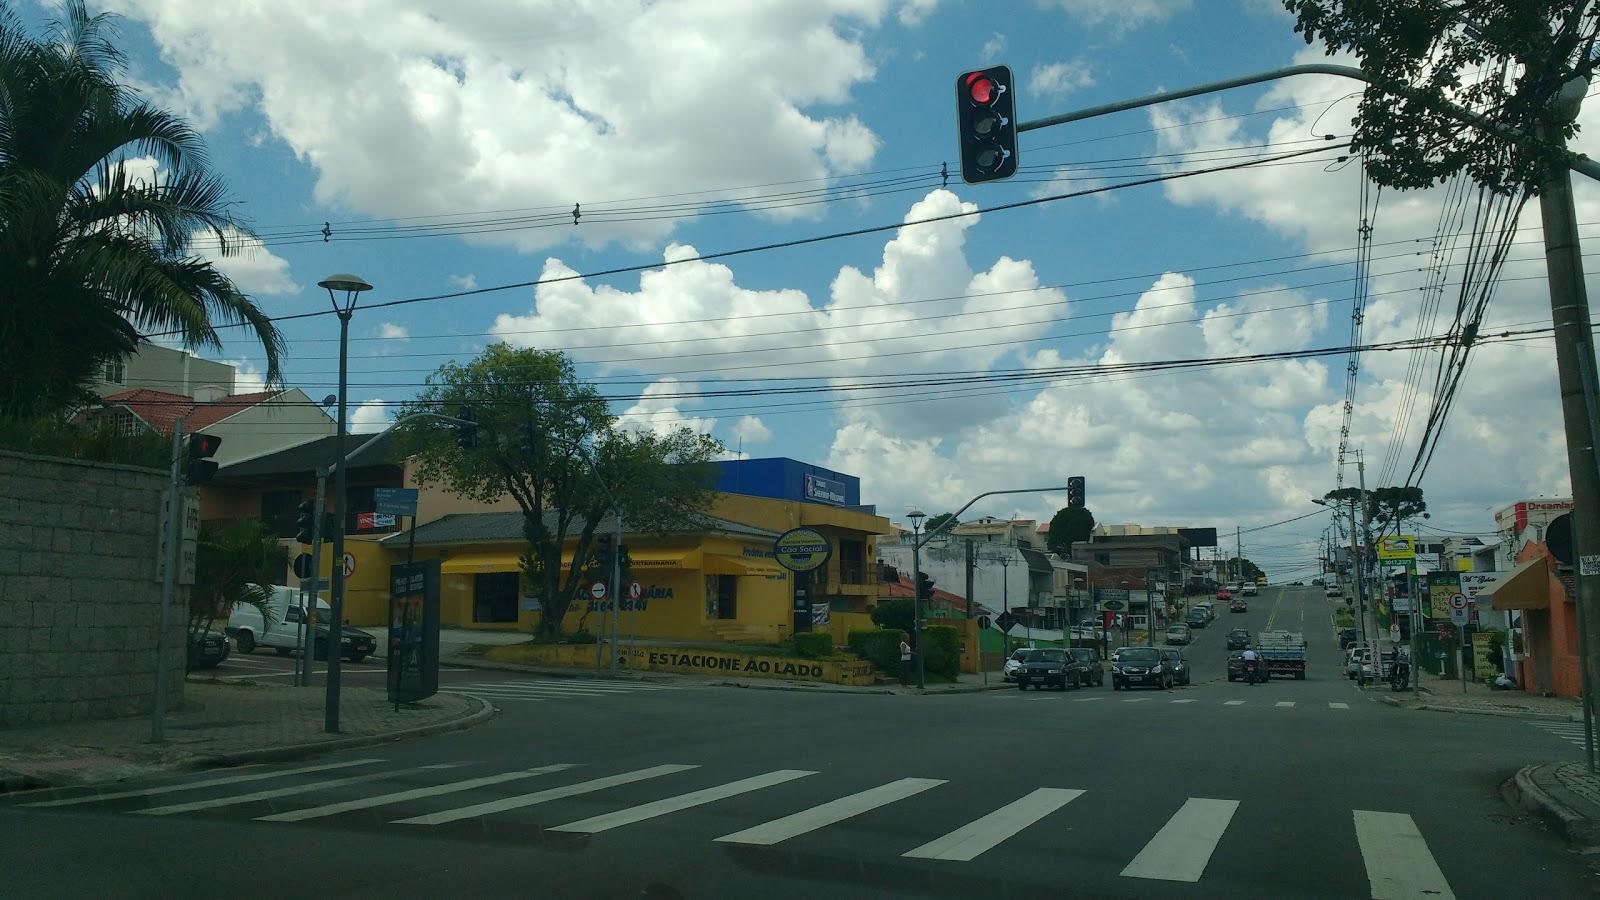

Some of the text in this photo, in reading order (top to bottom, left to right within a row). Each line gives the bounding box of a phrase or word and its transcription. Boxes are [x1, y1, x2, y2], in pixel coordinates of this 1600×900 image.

[800, 545, 822, 553] Social
[1455, 597, 1462, 605] E
[648, 652, 740, 671] ESTACIONE
[743, 659, 769, 673] AO
[773, 661, 823, 678] LADO
